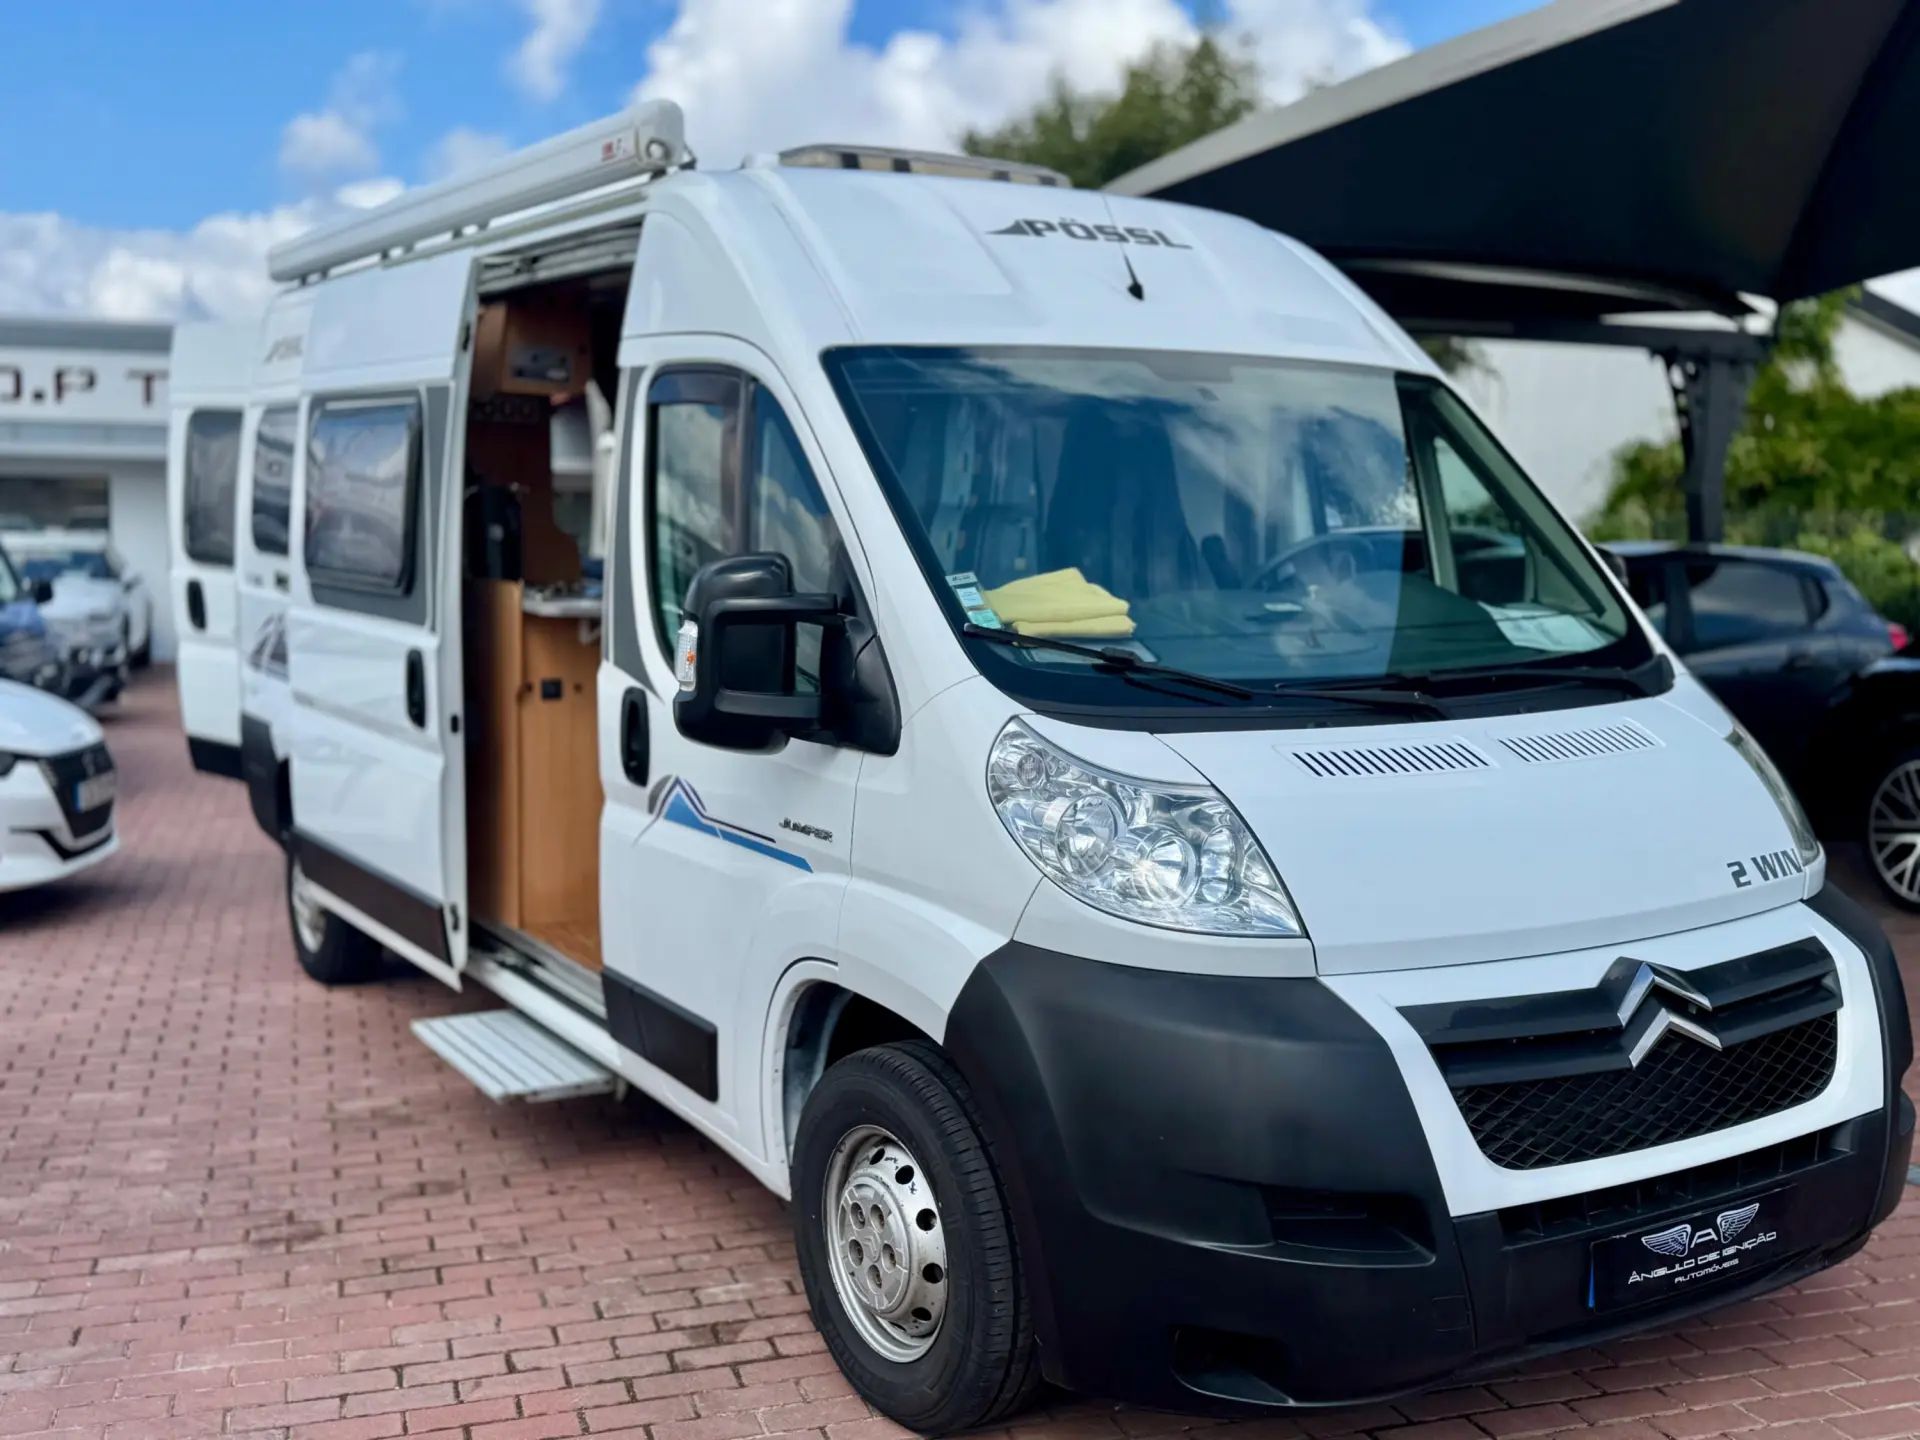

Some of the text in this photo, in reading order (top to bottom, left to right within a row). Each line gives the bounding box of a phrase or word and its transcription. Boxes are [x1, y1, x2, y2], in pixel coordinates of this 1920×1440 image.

[1021, 217, 1193, 250] PÖSSL
[779, 817, 833, 843] JUMPER
[1726, 848, 1803, 888] 2 WIN
[1697, 1251, 1721, 1265] DE
[1722, 1231, 1777, 1257] IGNIÇÃO
